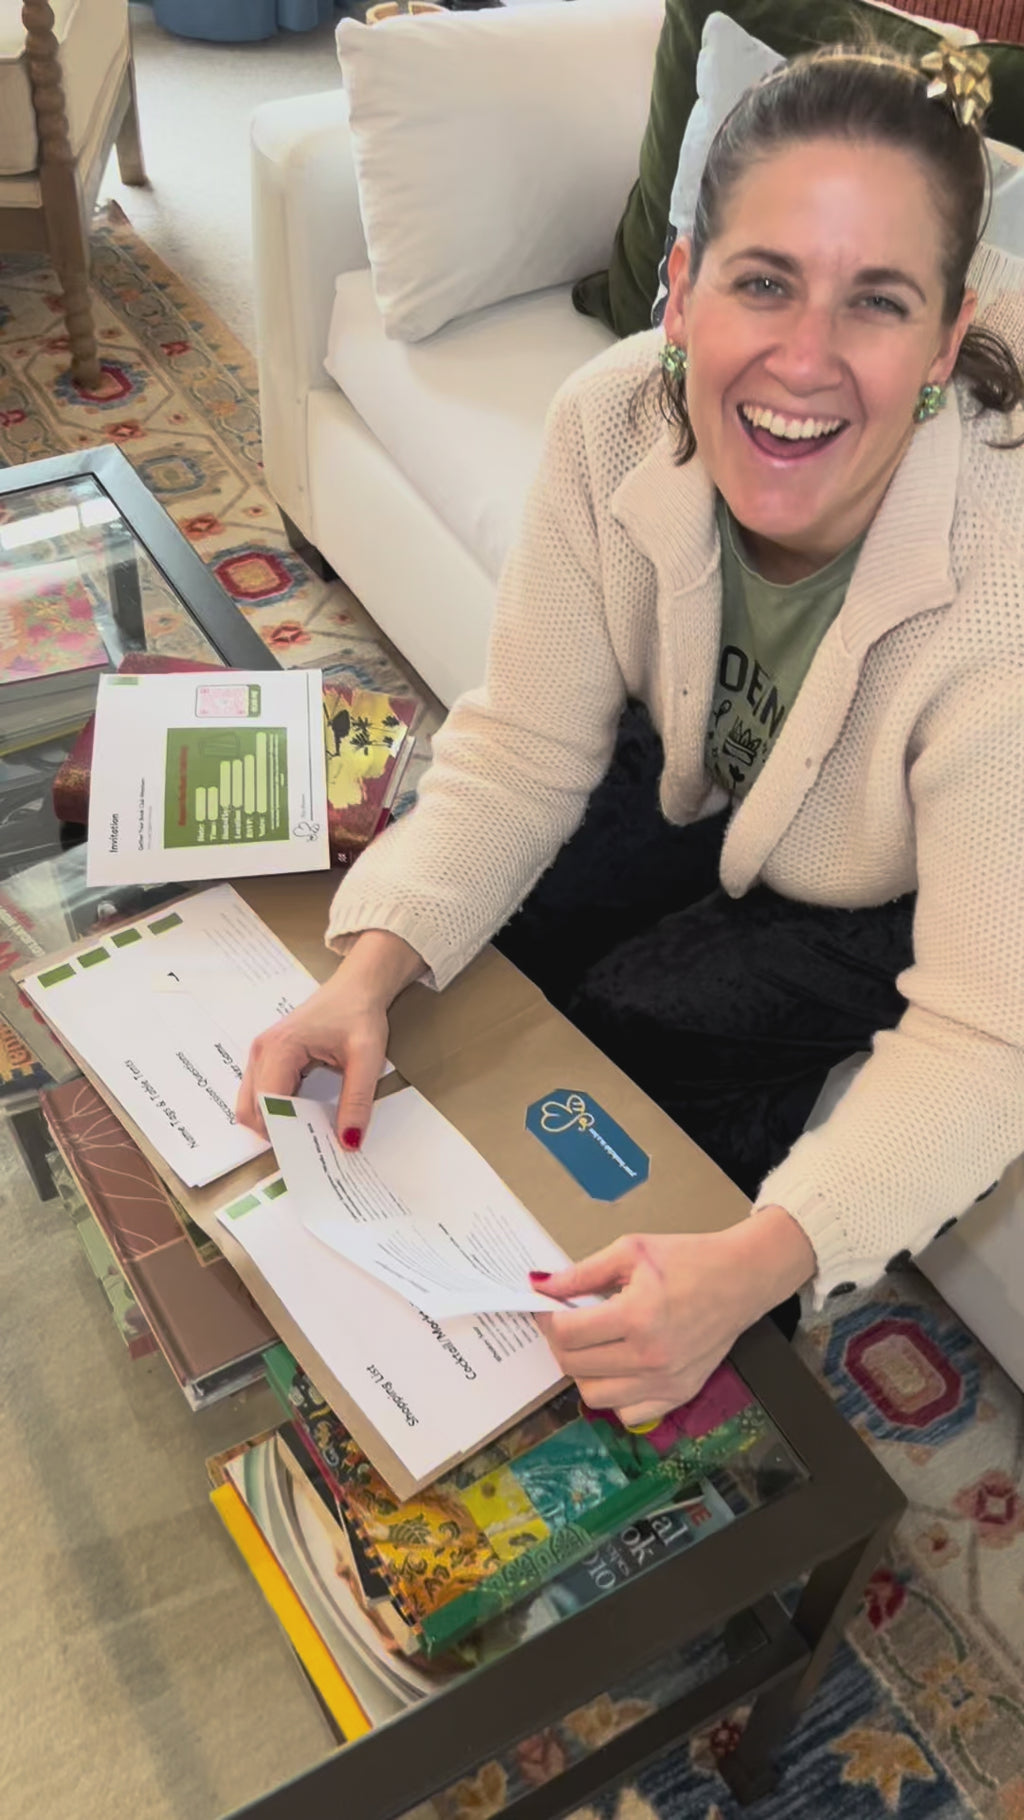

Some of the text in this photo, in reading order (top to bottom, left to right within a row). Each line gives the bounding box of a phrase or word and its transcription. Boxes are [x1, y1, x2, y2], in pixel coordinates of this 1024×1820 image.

[719, 644, 785, 738] OEN
[109, 812, 119, 853] Invitation
[213, 1042, 234, 1064] Game
[124, 1059, 199, 1149] Name Tags & Table Tents
[176, 1051, 237, 1126] Discussion Questions
[366, 1364, 419, 1427] Shopping List
